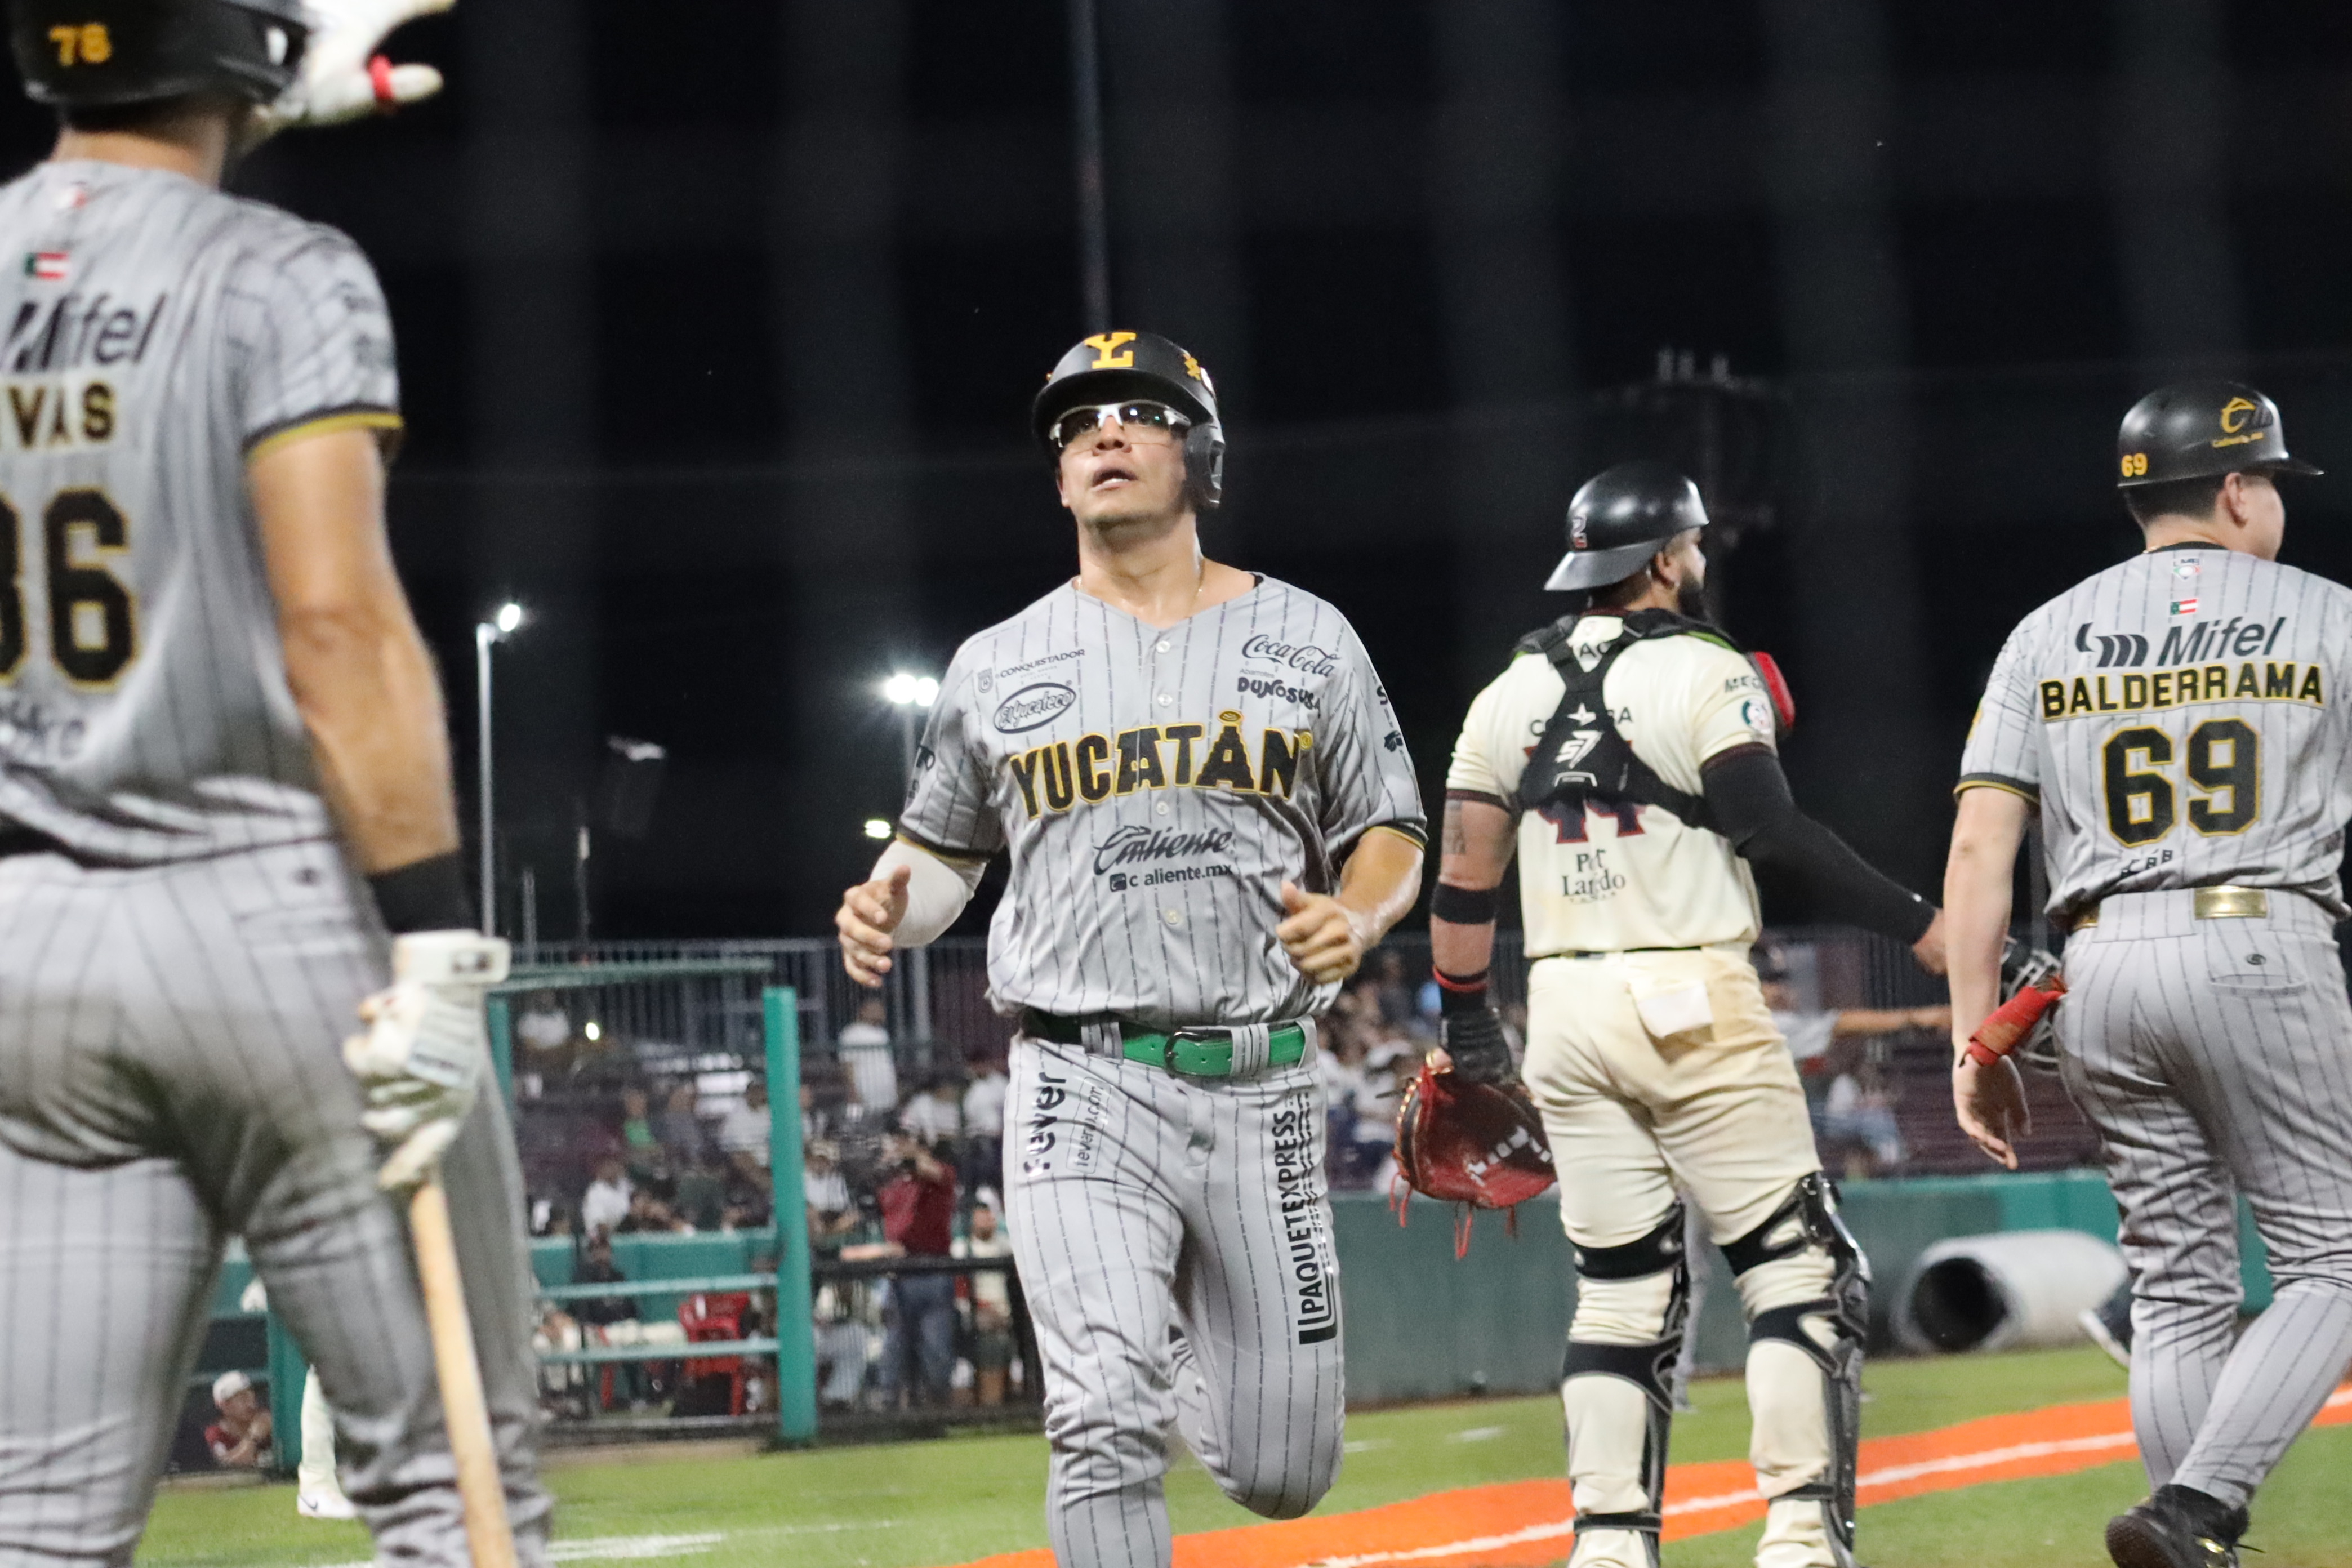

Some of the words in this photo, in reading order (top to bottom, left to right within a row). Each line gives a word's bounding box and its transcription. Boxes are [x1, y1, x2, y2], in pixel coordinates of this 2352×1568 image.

[2121, 452, 2148, 478] 69
[1000, 649, 1085, 678] CONQUISTADOR
[1241, 634, 1343, 678] Coca-Cola
[2157, 617, 2287, 667] Mifel
[1237, 677, 1321, 719] DUNOSUSA
[2039, 661, 2325, 722] BALDERRAMA
[2102, 716, 2261, 849] 69
[1093, 825, 1233, 876] Caliente
[1272, 1110, 1325, 1315] PAQUETEXPRESS
